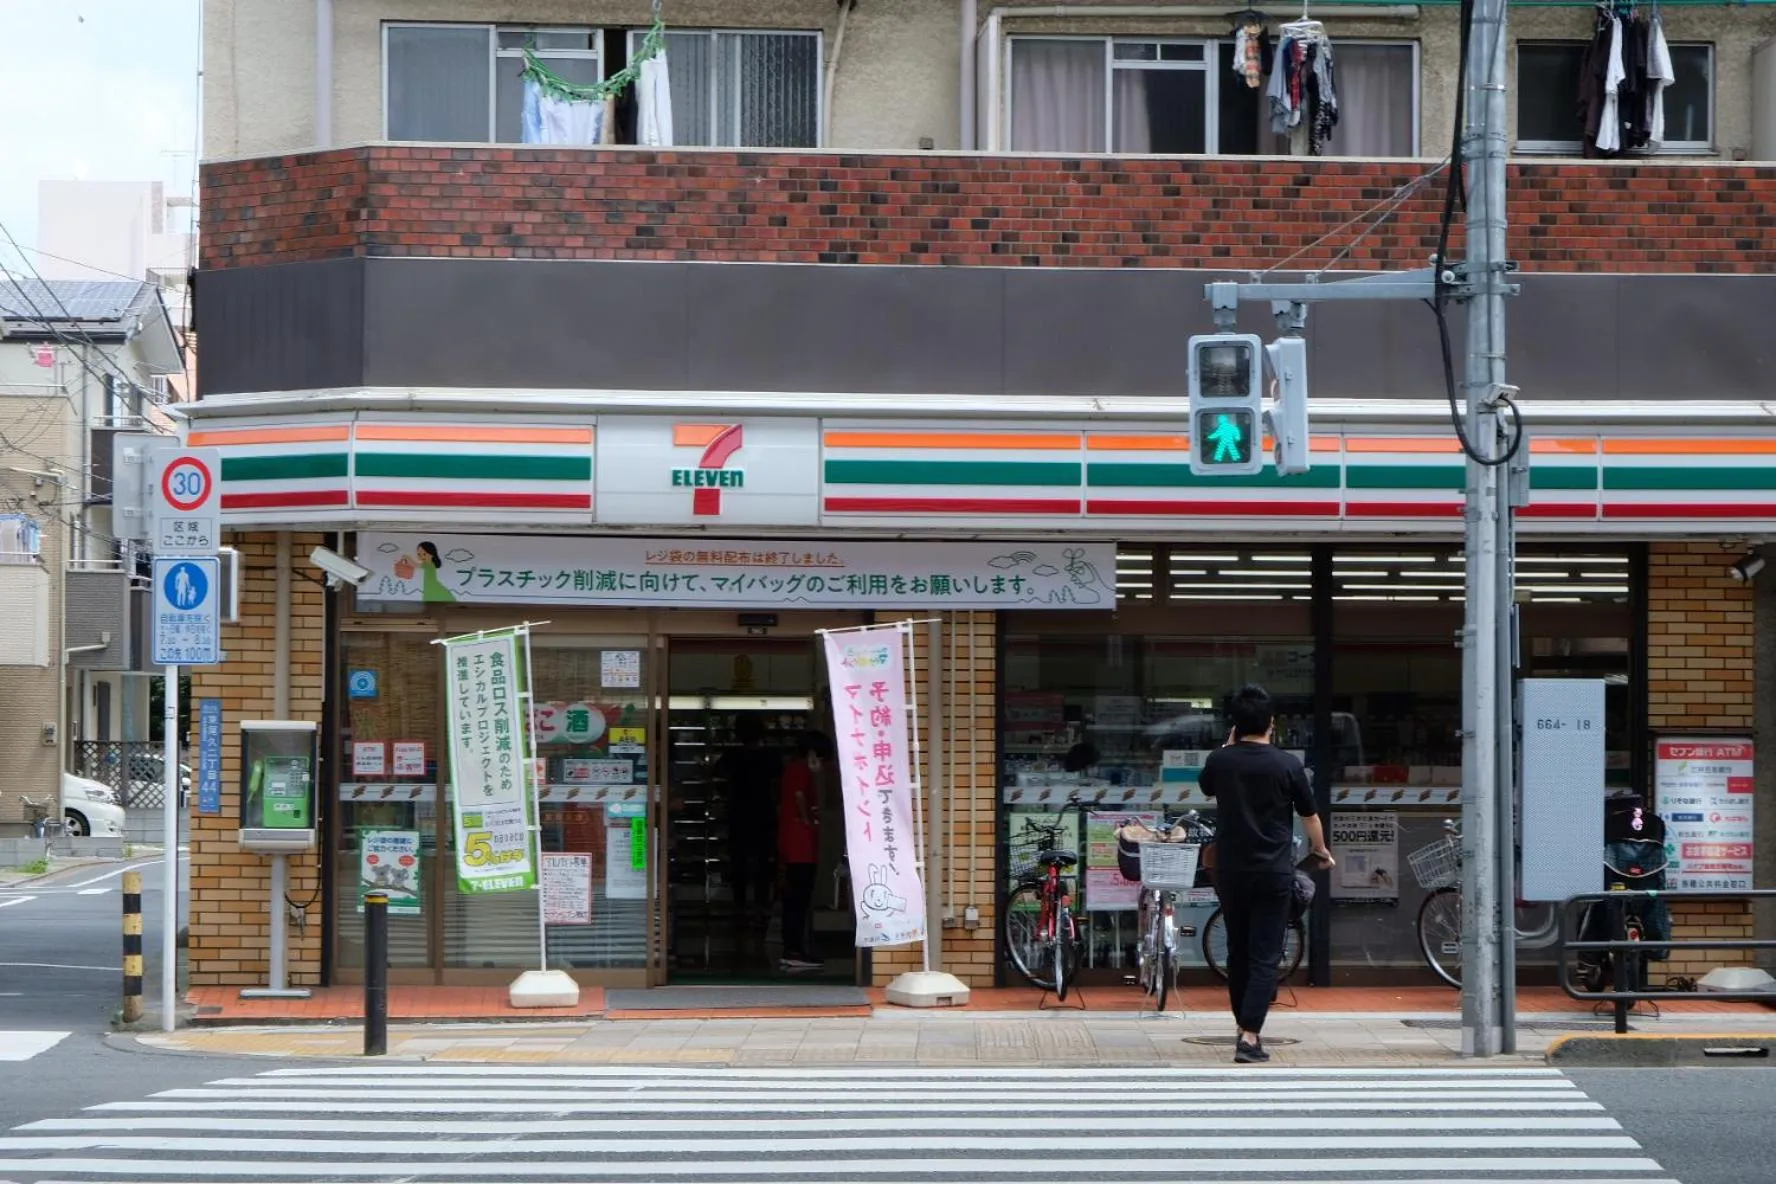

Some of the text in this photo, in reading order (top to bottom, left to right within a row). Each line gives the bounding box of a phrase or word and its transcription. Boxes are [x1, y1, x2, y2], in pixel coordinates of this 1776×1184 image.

[173, 471, 201, 496] 30
[173, 521, 199, 532] 区域
[163, 535, 209, 546] ここから
[645, 549, 844, 565] レジ袋の無料配布は終了しました。
[455, 568, 1035, 596] プラスチック削減に向けて、マイバッグのご利用をお願いします。
[456, 656, 473, 753] 推進しています。
[473, 654, 494, 796] エシカルプロジェクトを
[490, 651, 513, 791] 食品ロス削減のため
[566, 710, 589, 732] 酒
[1576, 719, 1591, 730] 18
[1716, 747, 1743, 757] ATM
